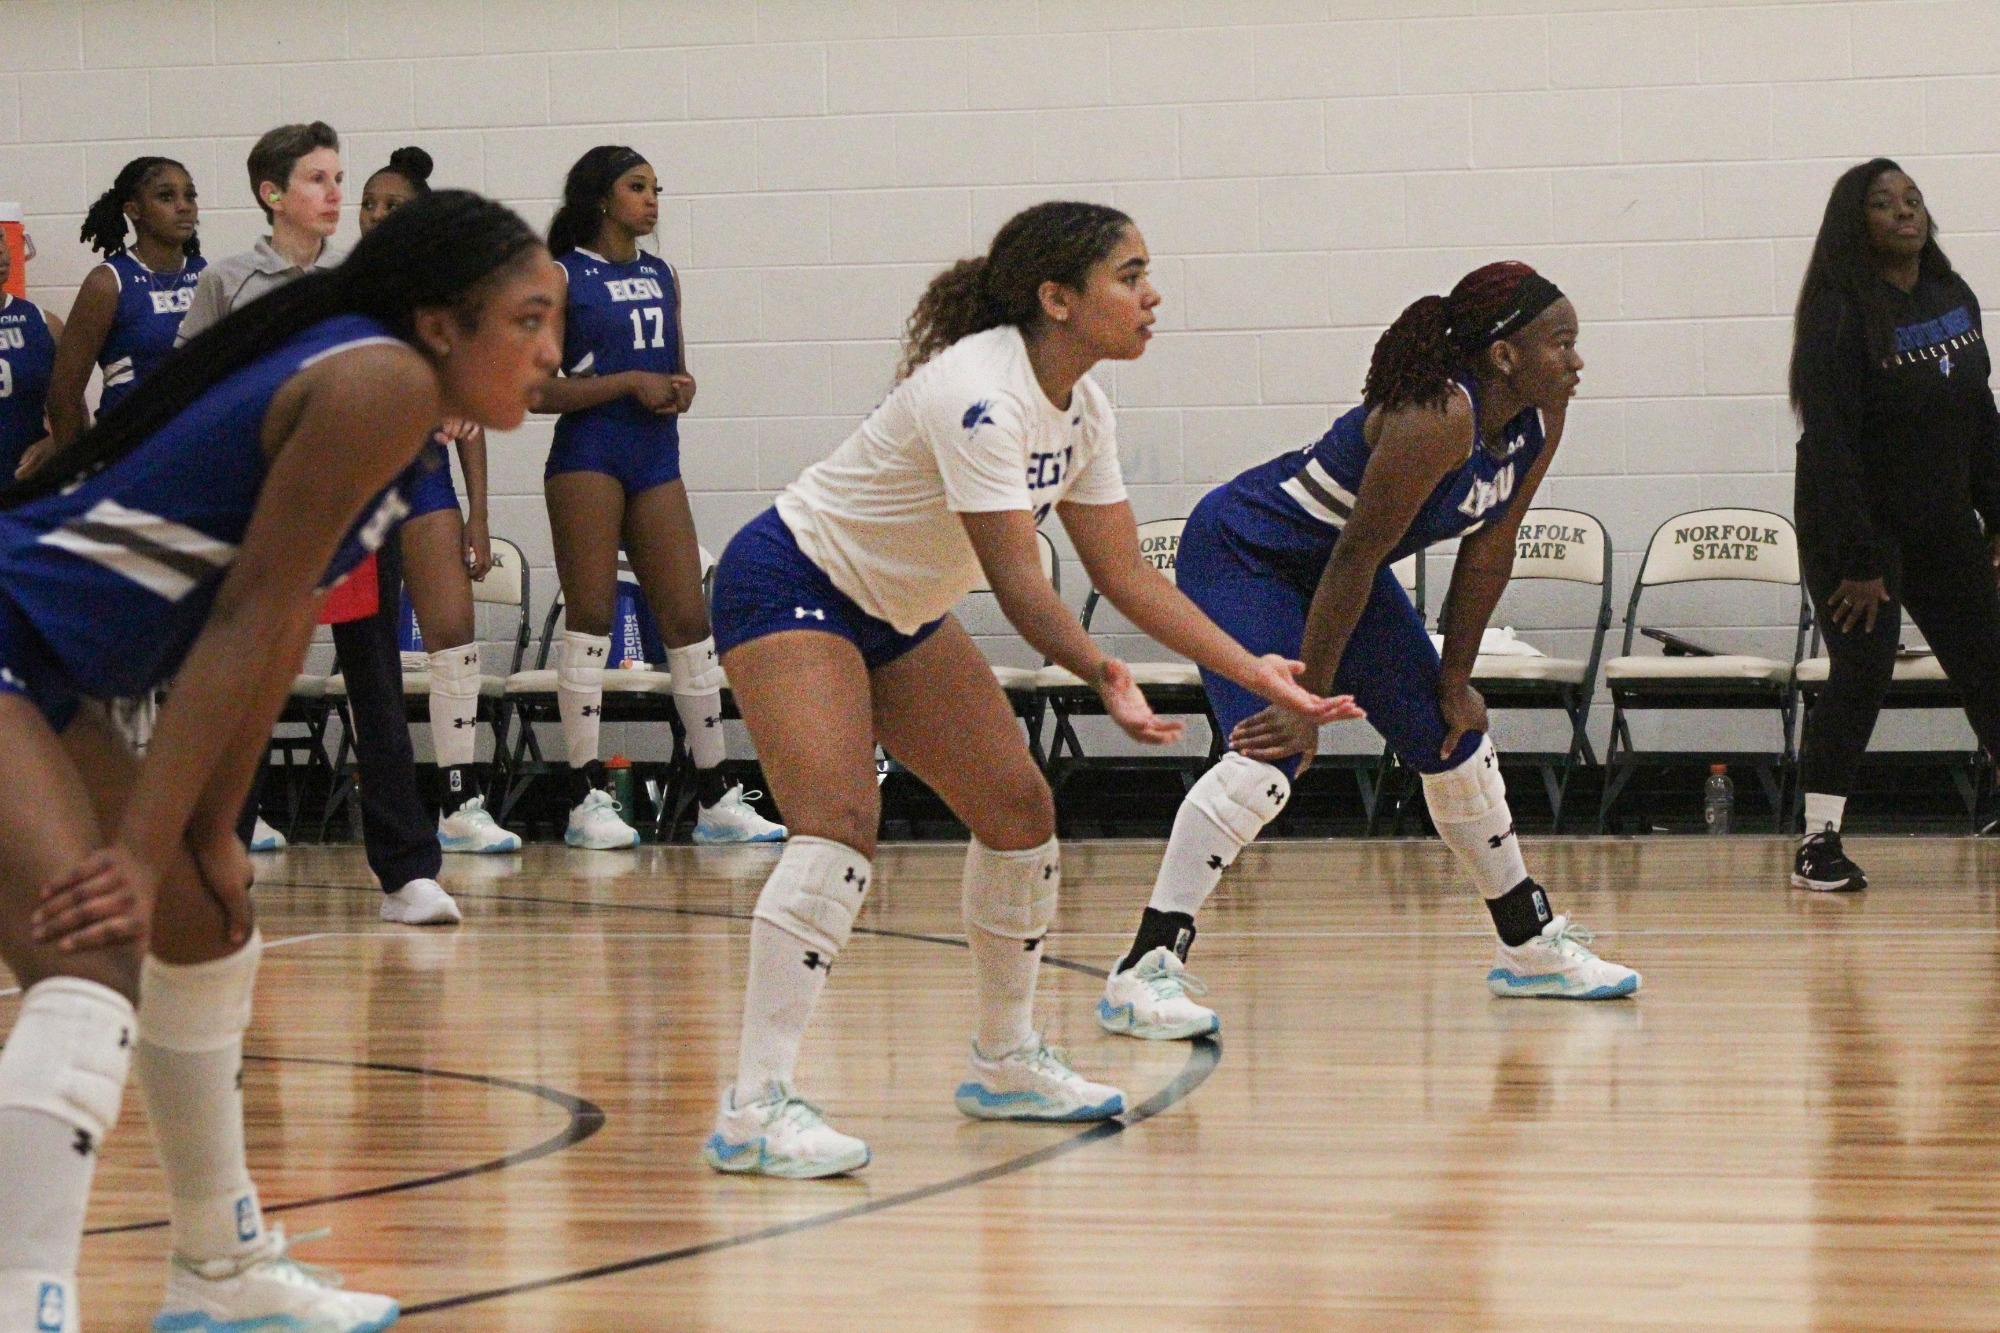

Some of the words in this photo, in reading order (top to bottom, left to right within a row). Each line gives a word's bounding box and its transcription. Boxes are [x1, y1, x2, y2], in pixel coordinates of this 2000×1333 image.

[604, 278, 664, 302] ECSU
[148, 287, 196, 314] ECS
[0, 314, 27, 323] CIAA
[629, 306, 665, 350] 17
[1517, 524, 1588, 545] RFOLK
[1674, 525, 1779, 545] NORFOLK
[1515, 542, 1567, 561] TATE
[1693, 543, 1759, 561] STATE
